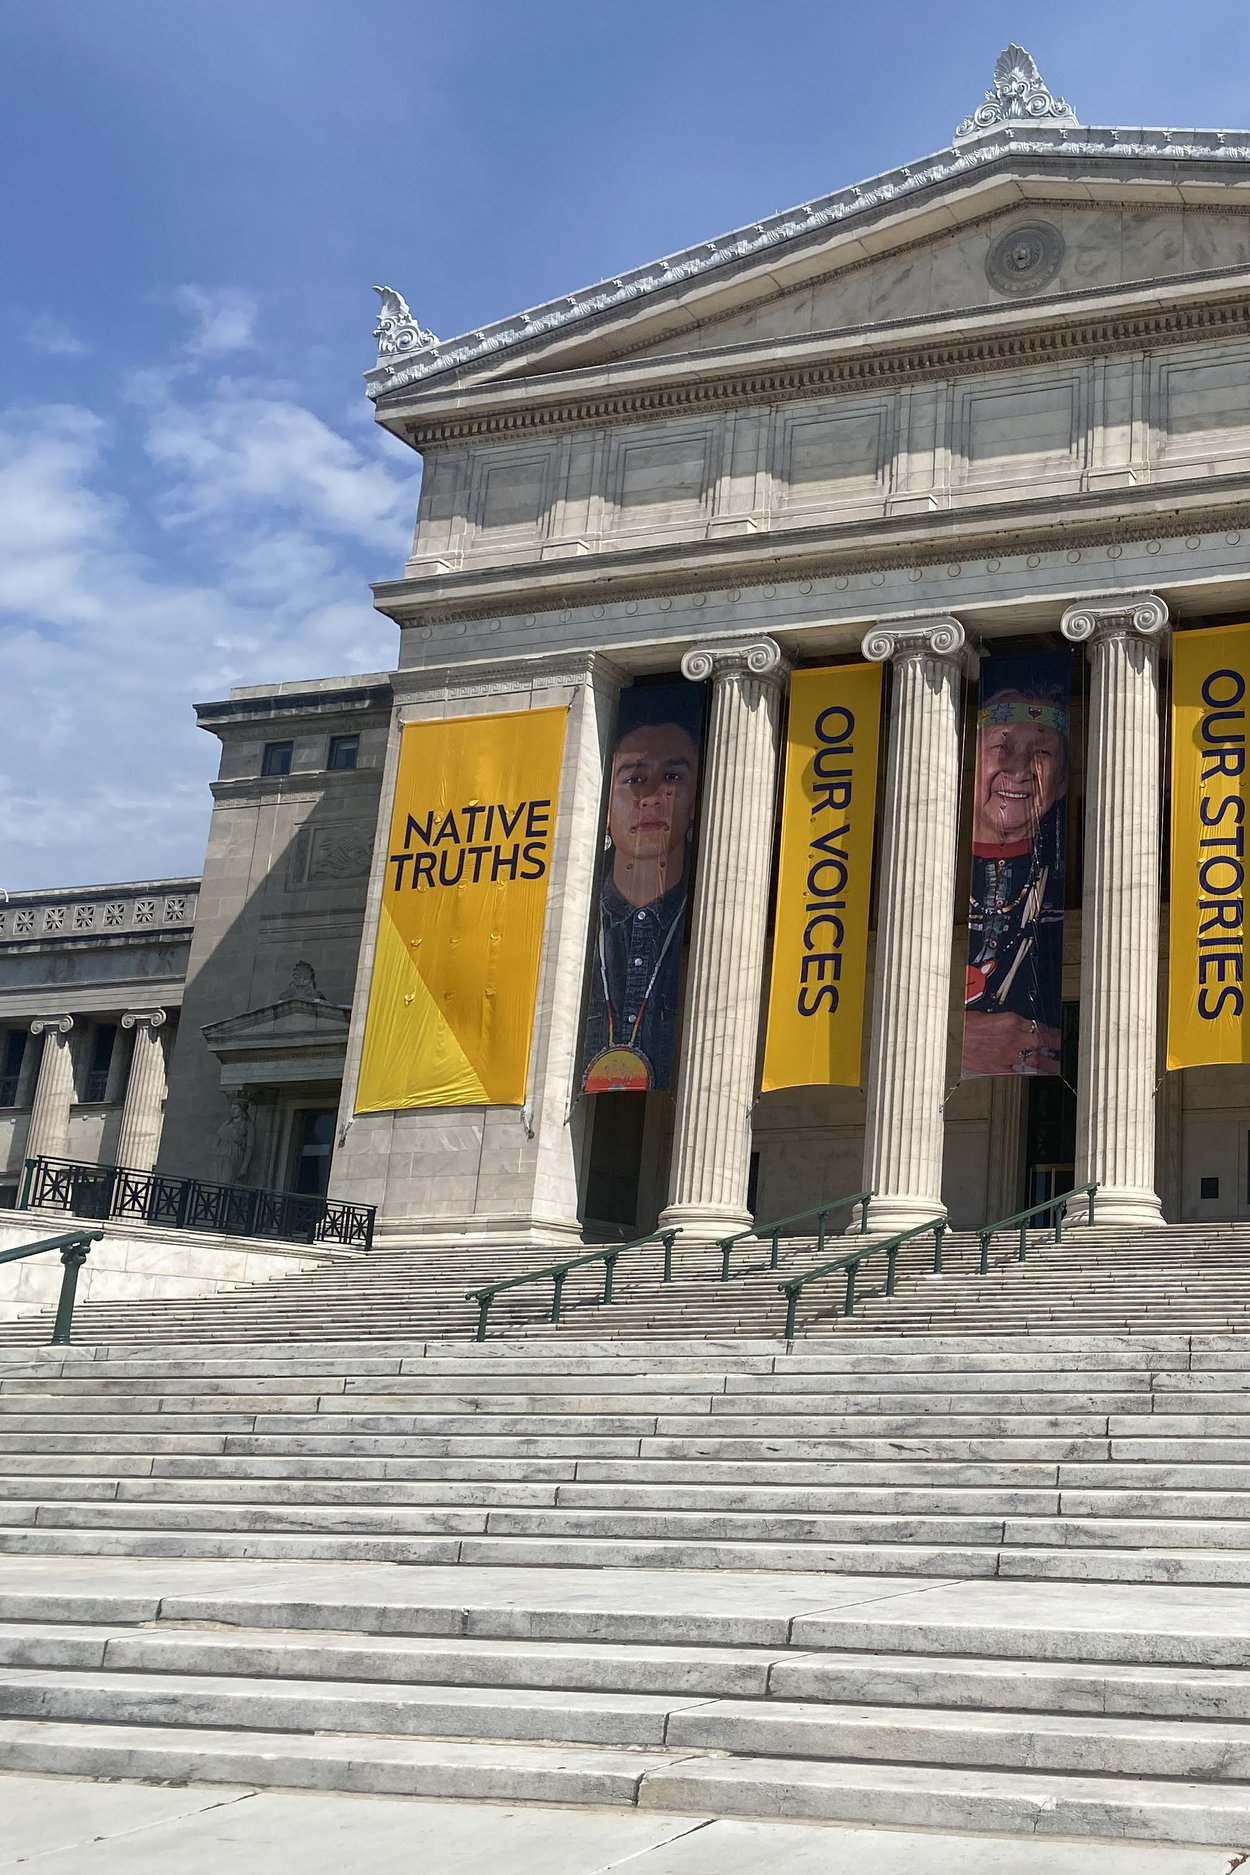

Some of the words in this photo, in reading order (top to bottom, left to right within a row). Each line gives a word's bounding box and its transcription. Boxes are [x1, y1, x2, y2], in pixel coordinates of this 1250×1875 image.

[810, 705, 856, 812] OUR
[1201, 668, 1246, 778] OUR
[390, 841, 547, 892] TRUTHS
[403, 799, 551, 850] NATIVE
[797, 824, 850, 1018] VOICES
[1197, 795, 1246, 1021] STORIES
